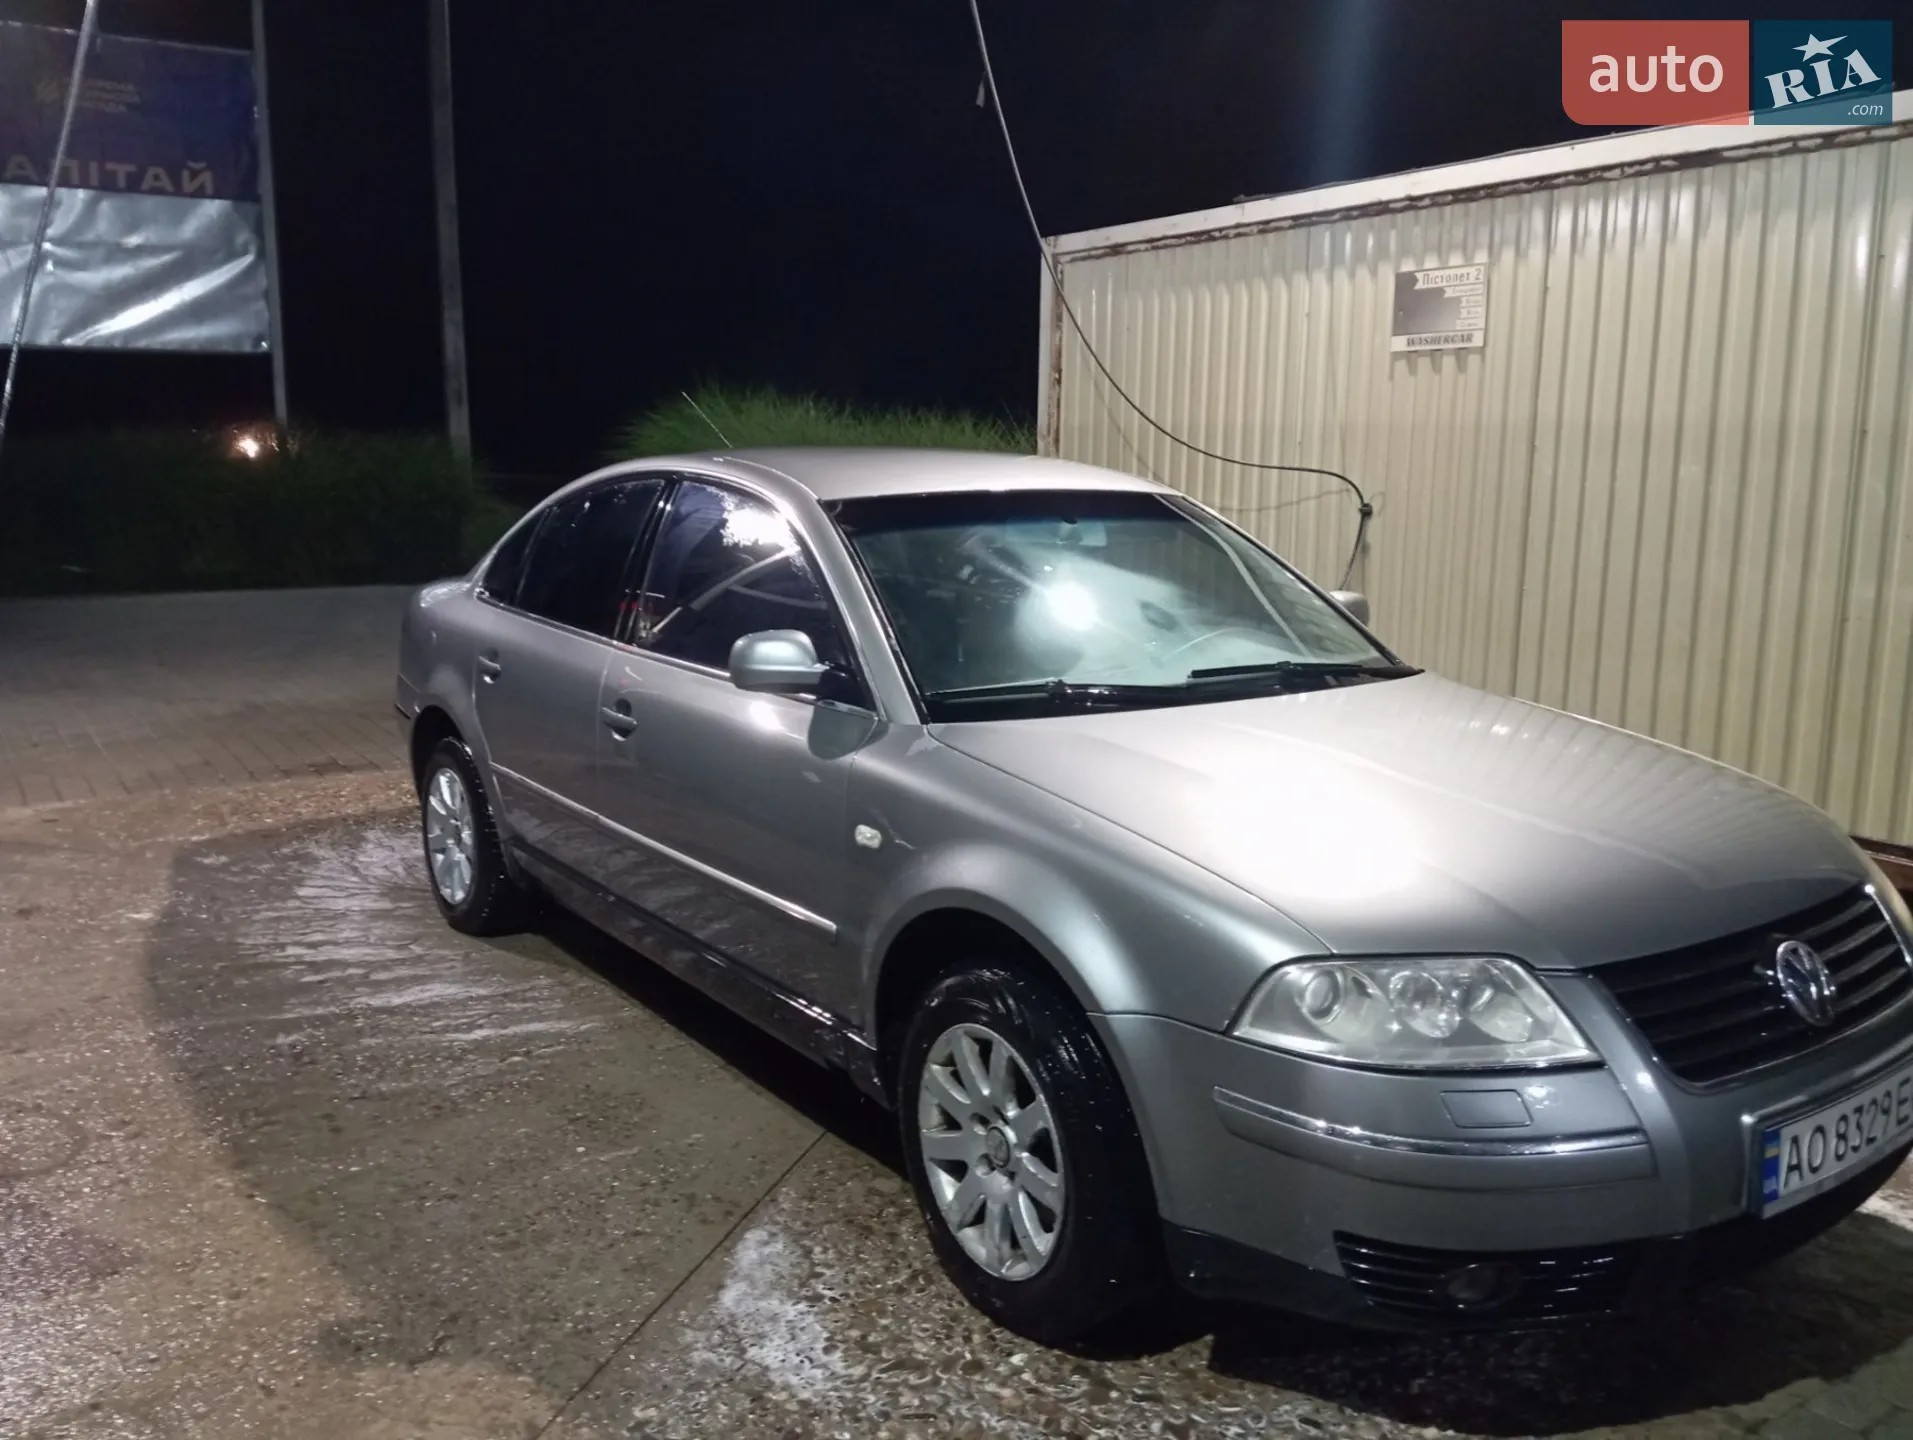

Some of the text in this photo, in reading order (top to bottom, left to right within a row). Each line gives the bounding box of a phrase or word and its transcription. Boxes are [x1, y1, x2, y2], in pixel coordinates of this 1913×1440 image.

[1475, 267, 1482, 281] 2
[1834, 1089, 1893, 1162] 8329
[1895, 1076, 1913, 1127] E
